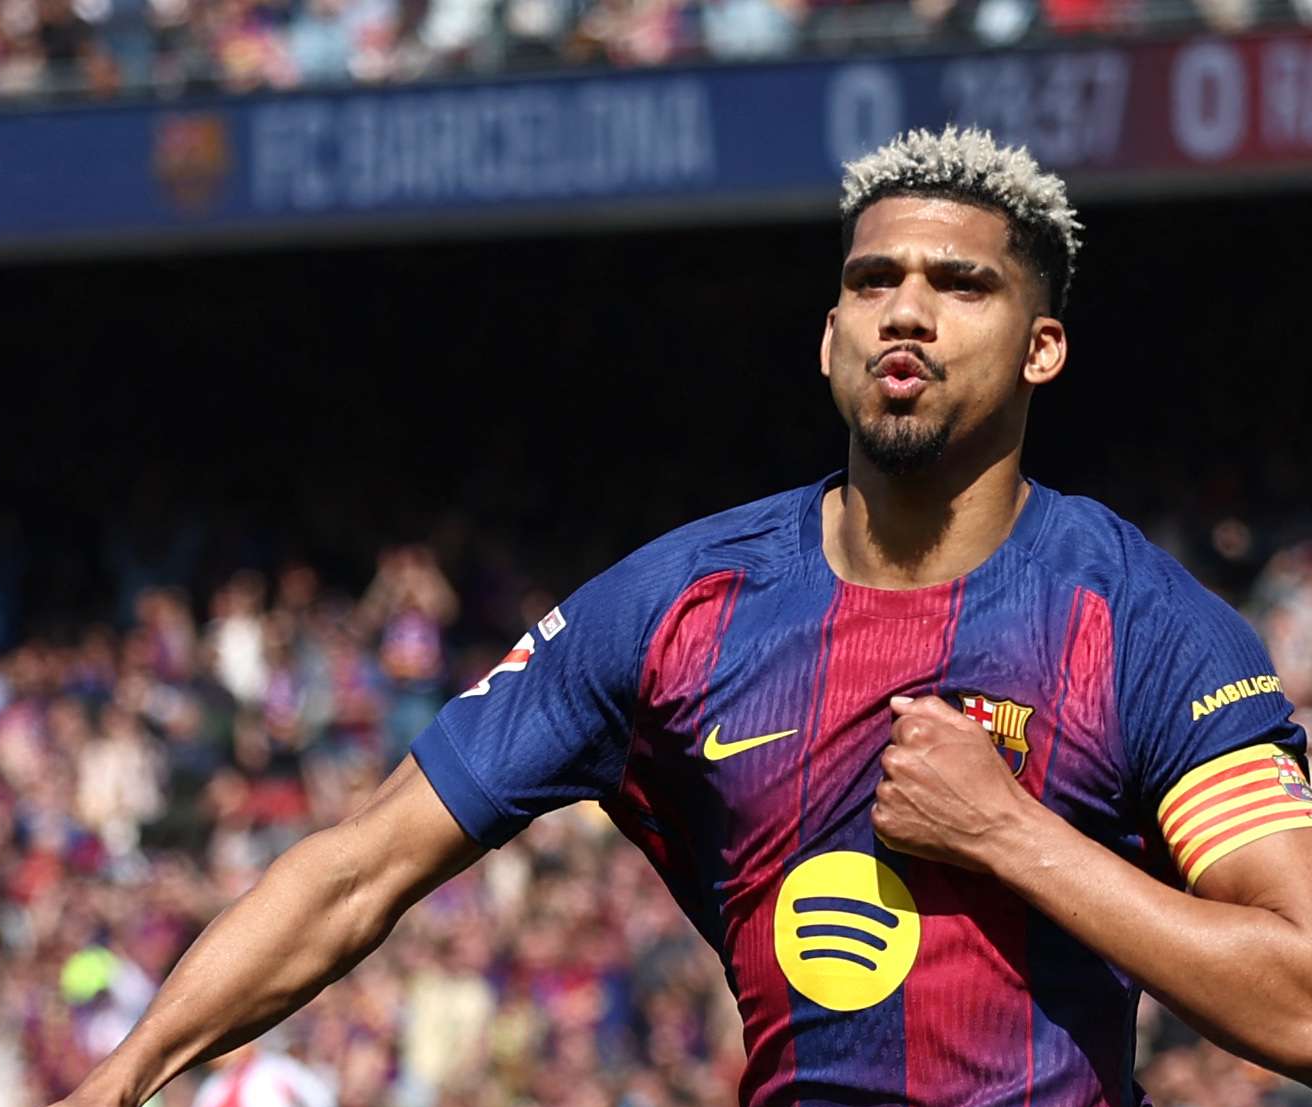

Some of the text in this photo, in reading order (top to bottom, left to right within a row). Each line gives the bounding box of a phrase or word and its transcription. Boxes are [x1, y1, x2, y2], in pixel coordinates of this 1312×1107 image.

[252, 78, 715, 211] FC BARCELONA
[1170, 41, 1246, 160] 0
